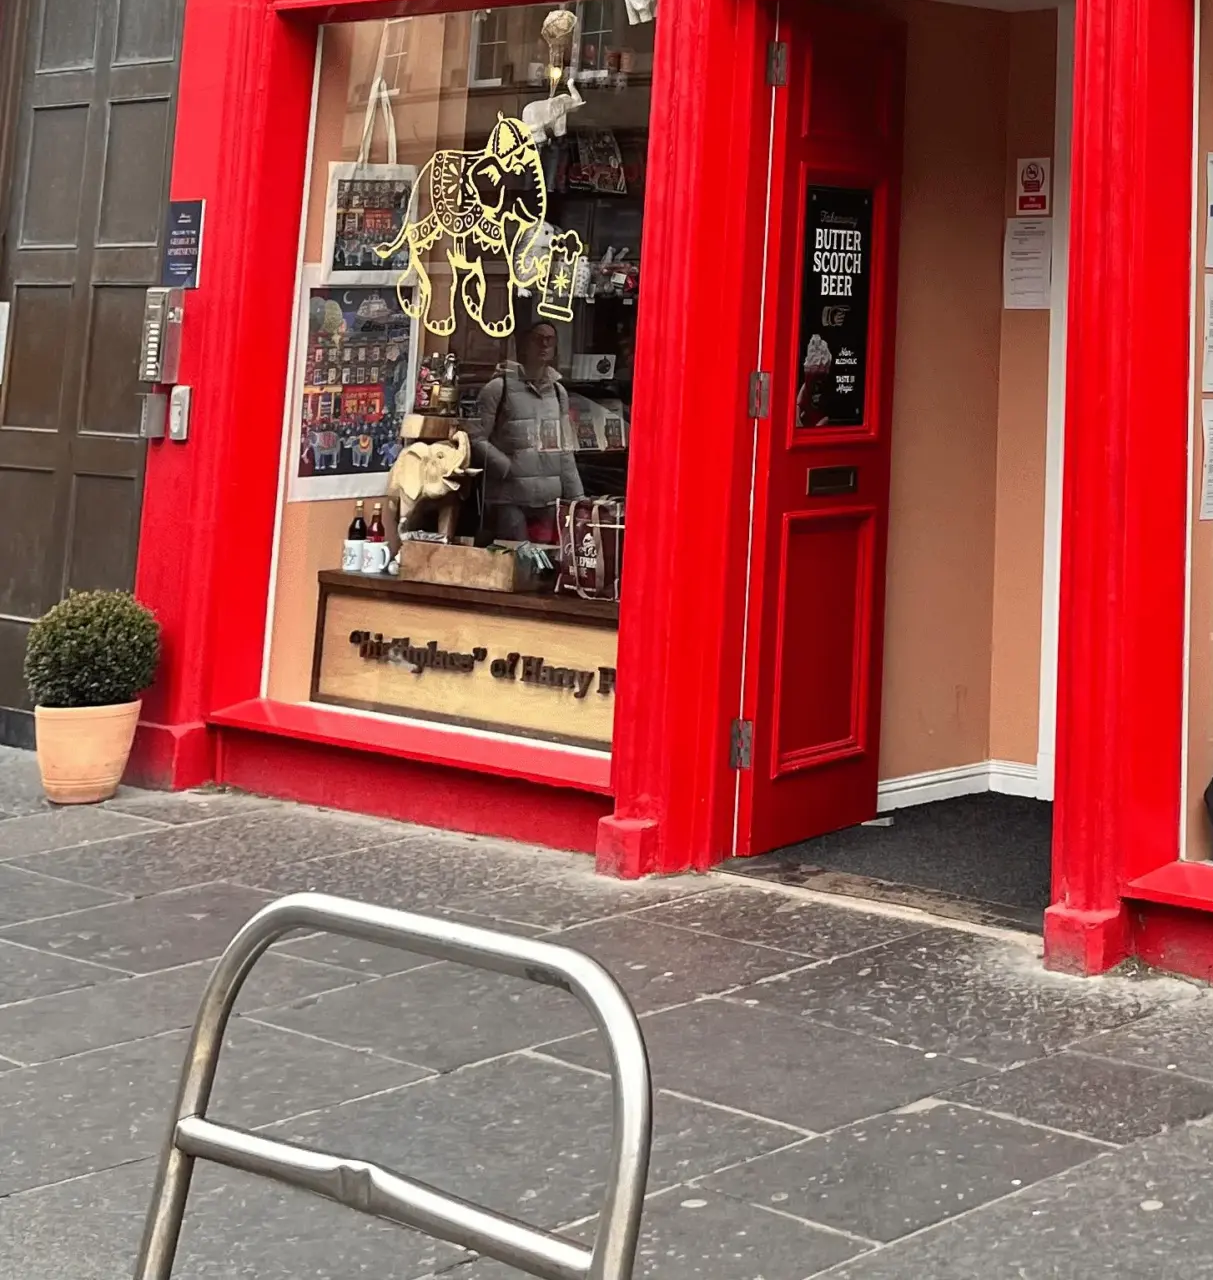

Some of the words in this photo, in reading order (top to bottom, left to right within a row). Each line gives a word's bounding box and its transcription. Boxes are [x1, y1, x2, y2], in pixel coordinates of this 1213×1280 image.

[815, 227, 861, 252] BUTTER
[813, 251, 861, 274] SCOTCH
[820, 274, 853, 296] BEER
[490, 652, 520, 680] of
[520, 655, 595, 699] Harry
